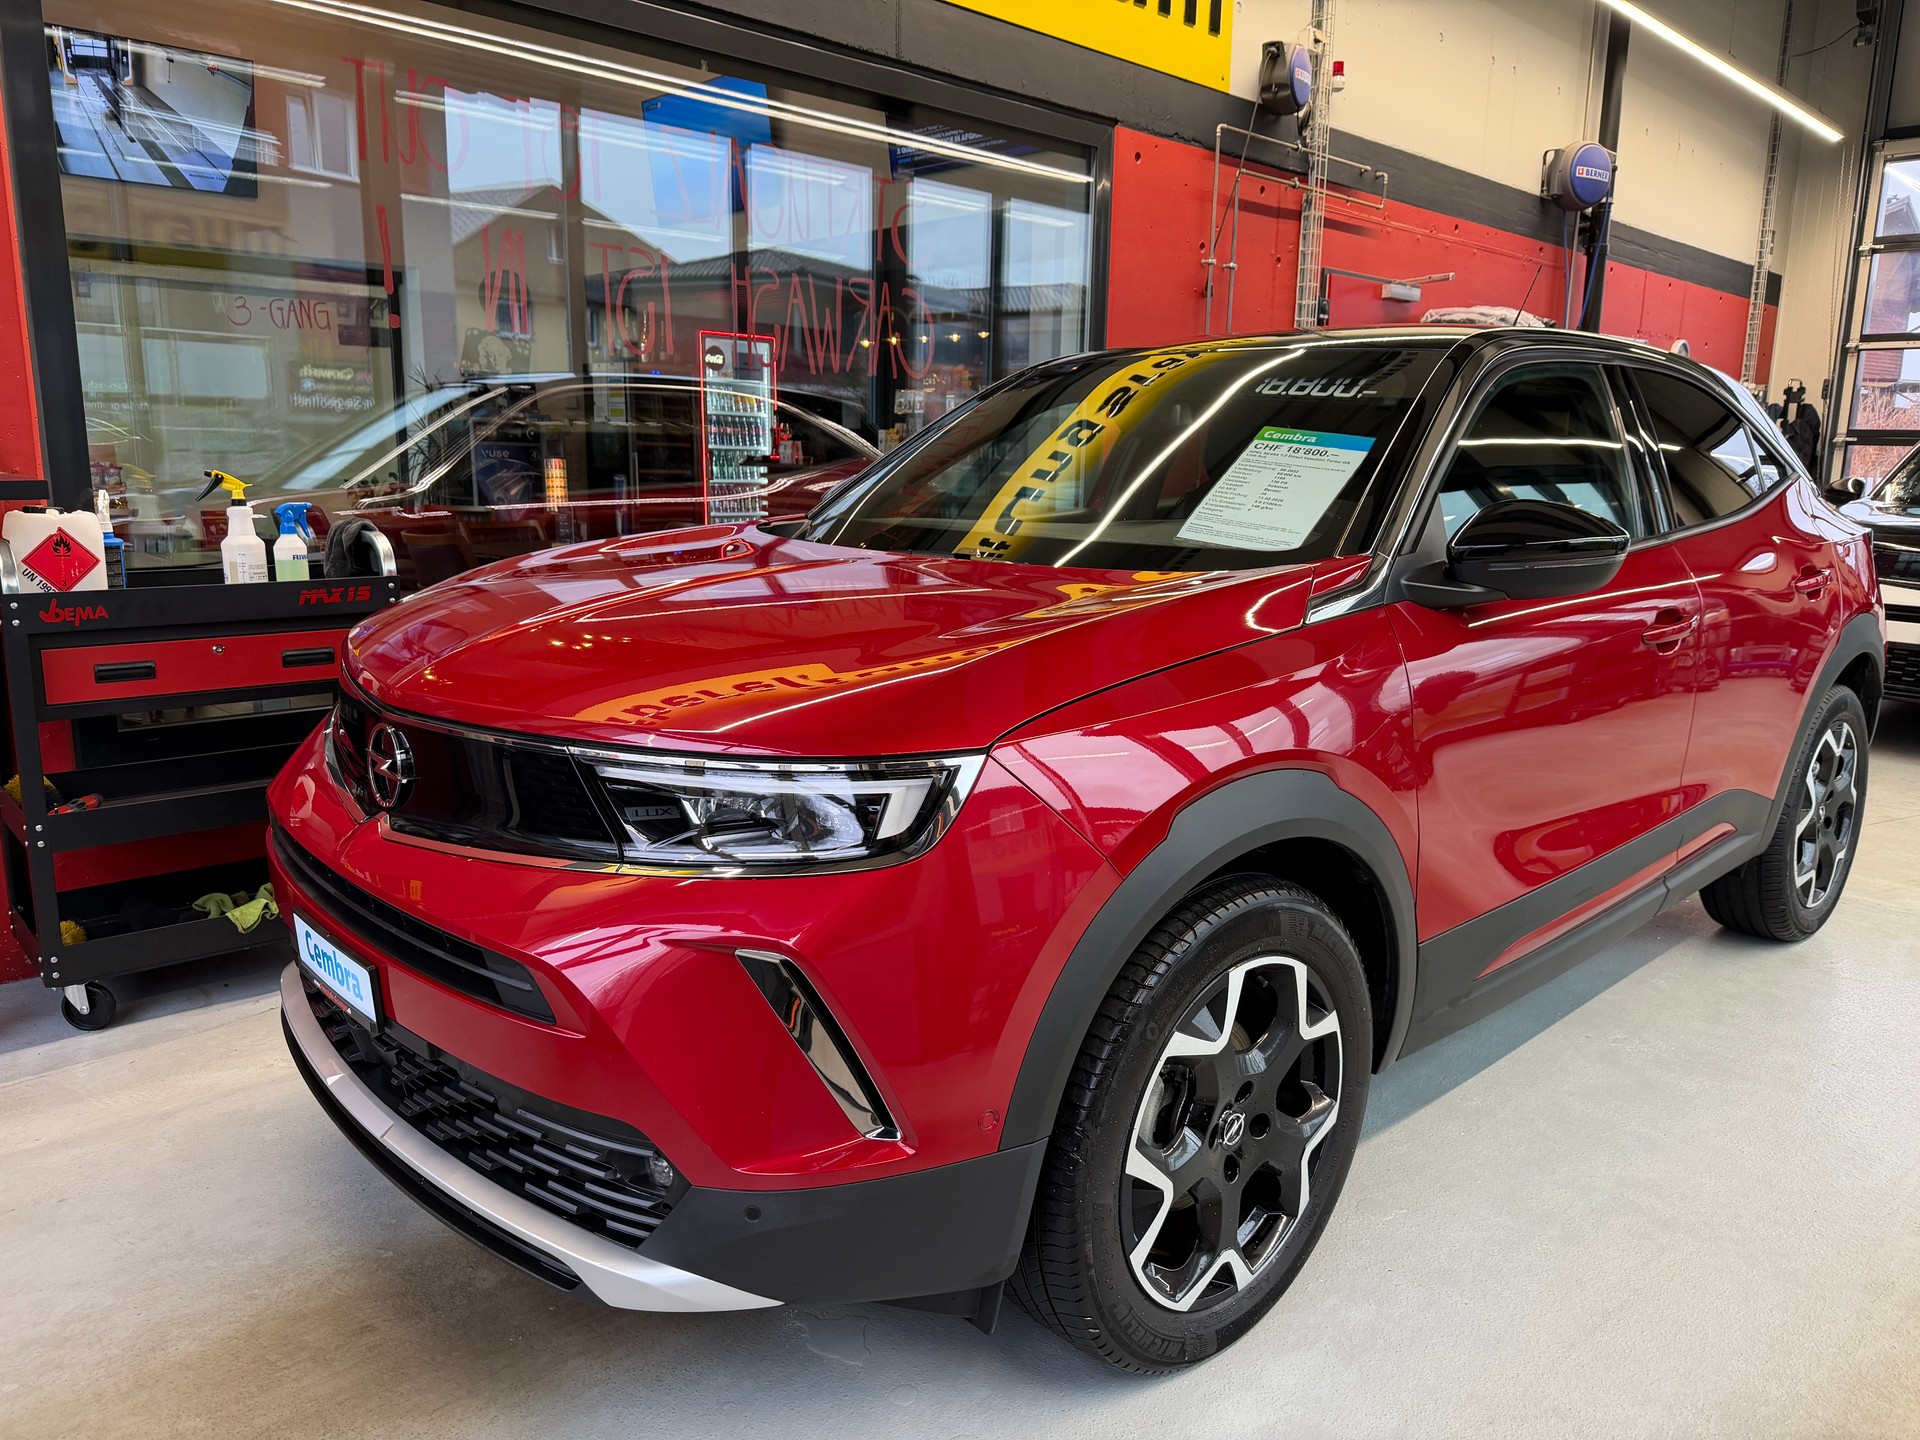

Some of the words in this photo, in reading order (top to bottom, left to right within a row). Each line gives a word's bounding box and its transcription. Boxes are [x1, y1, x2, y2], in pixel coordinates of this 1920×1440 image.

[1585, 168, 1608, 180] BERNER
[1263, 430, 1318, 443] Cembra
[1254, 442, 1284, 452] CHF
[22, 568, 38, 582] UN
[305, 929, 364, 1002] Cembra
[1112, 1298, 1184, 1359] MICHELIN
